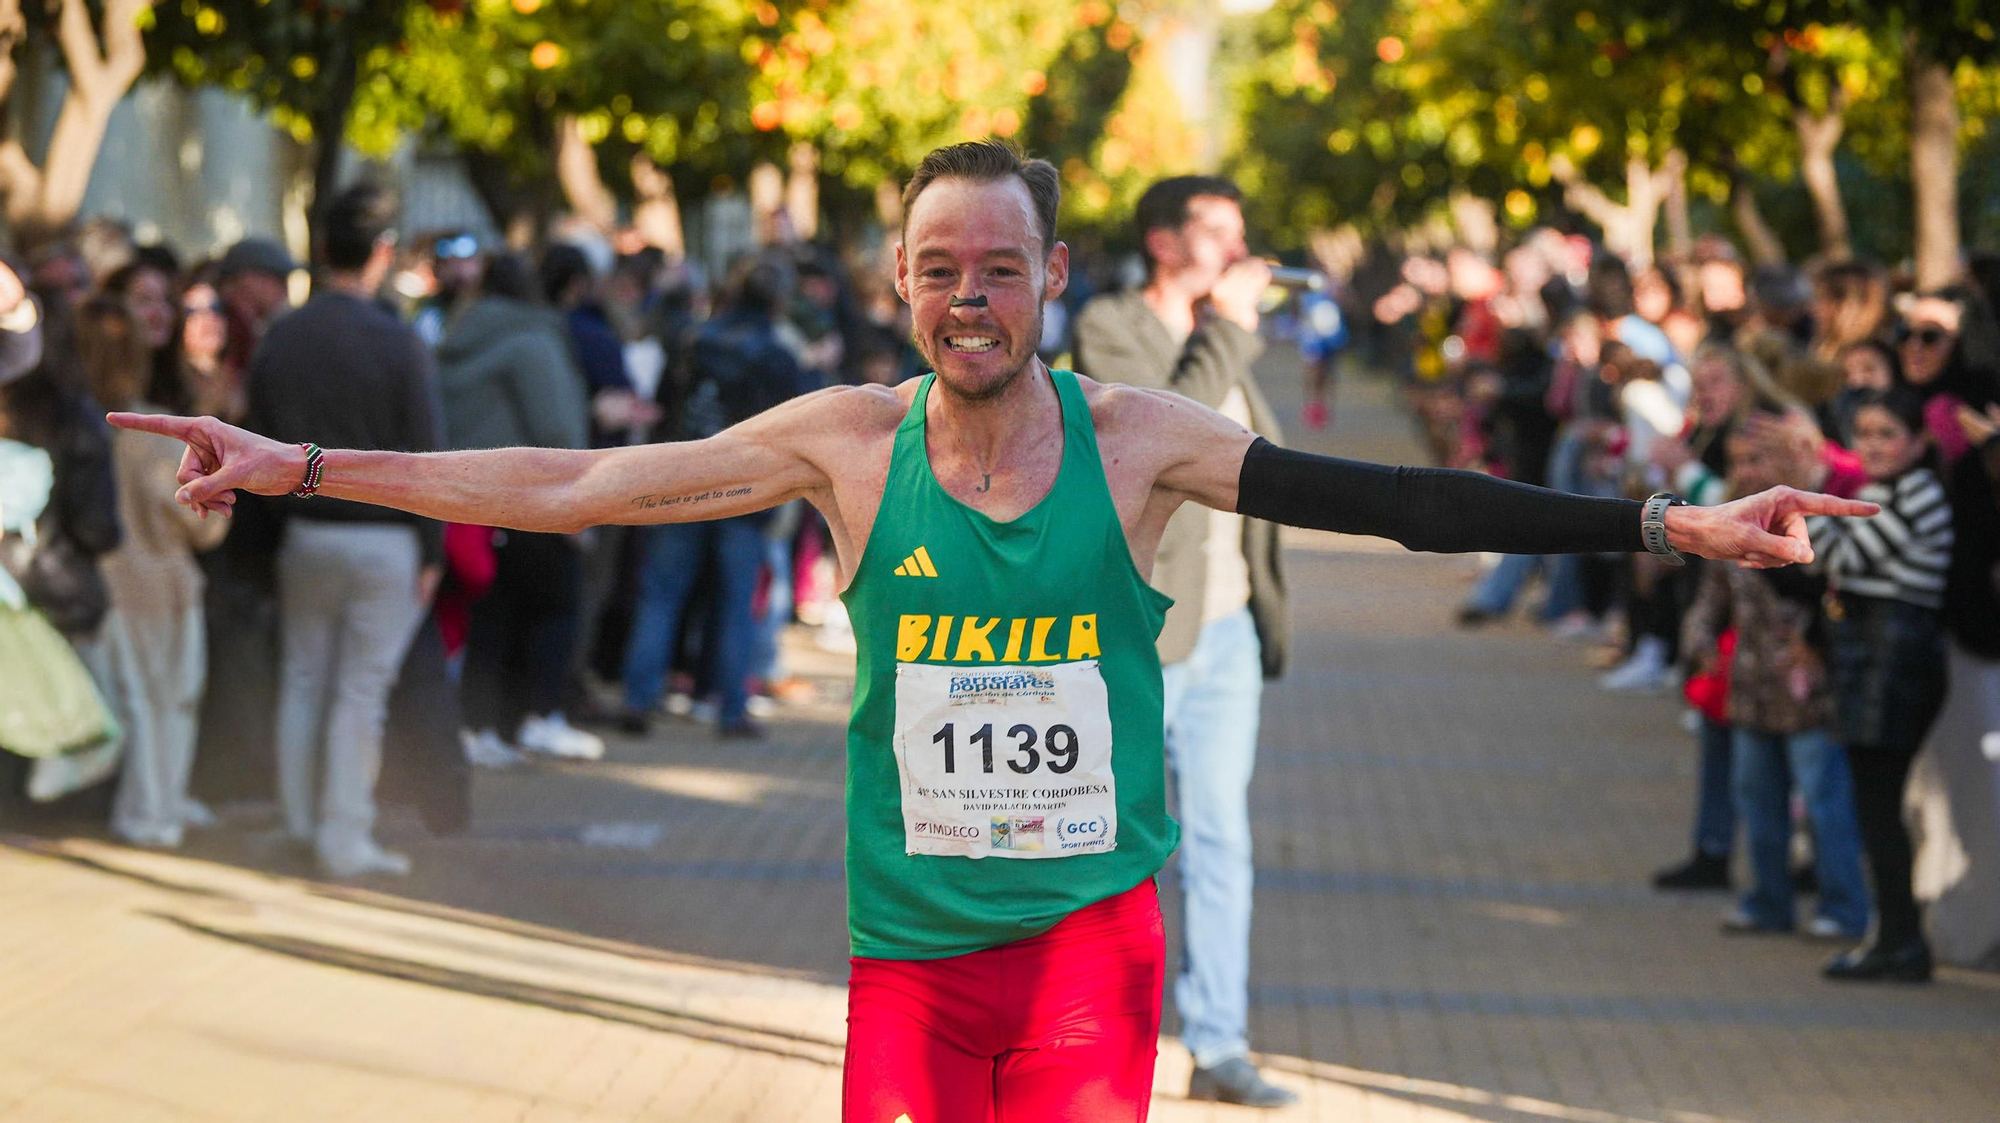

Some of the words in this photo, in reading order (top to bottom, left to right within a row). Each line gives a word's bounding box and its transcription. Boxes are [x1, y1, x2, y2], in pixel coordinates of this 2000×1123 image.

[976, 473, 991, 493] J
[631, 494, 656, 510] The
[660, 496, 680, 507] best
[692, 492, 709, 504] yet
[713, 490, 722, 499] to
[726, 487, 753, 498] come
[895, 613, 1102, 662] BIKILA
[949, 679, 1055, 693] populares
[950, 673, 1038, 685] carreras
[932, 722, 1079, 774] 1139
[932, 788, 956, 799] SAN
[959, 788, 1029, 799] SILVESTRE
[1032, 784, 1108, 799] CORDOBESA
[963, 803, 991, 811] DAVID
[993, 803, 1031, 811] PALACIO
[929, 822, 980, 839] IMDECO
[1067, 821, 1097, 834] GCC
[1061, 842, 1081, 850] SPORT
[1082, 839, 1105, 848] EVENTS
